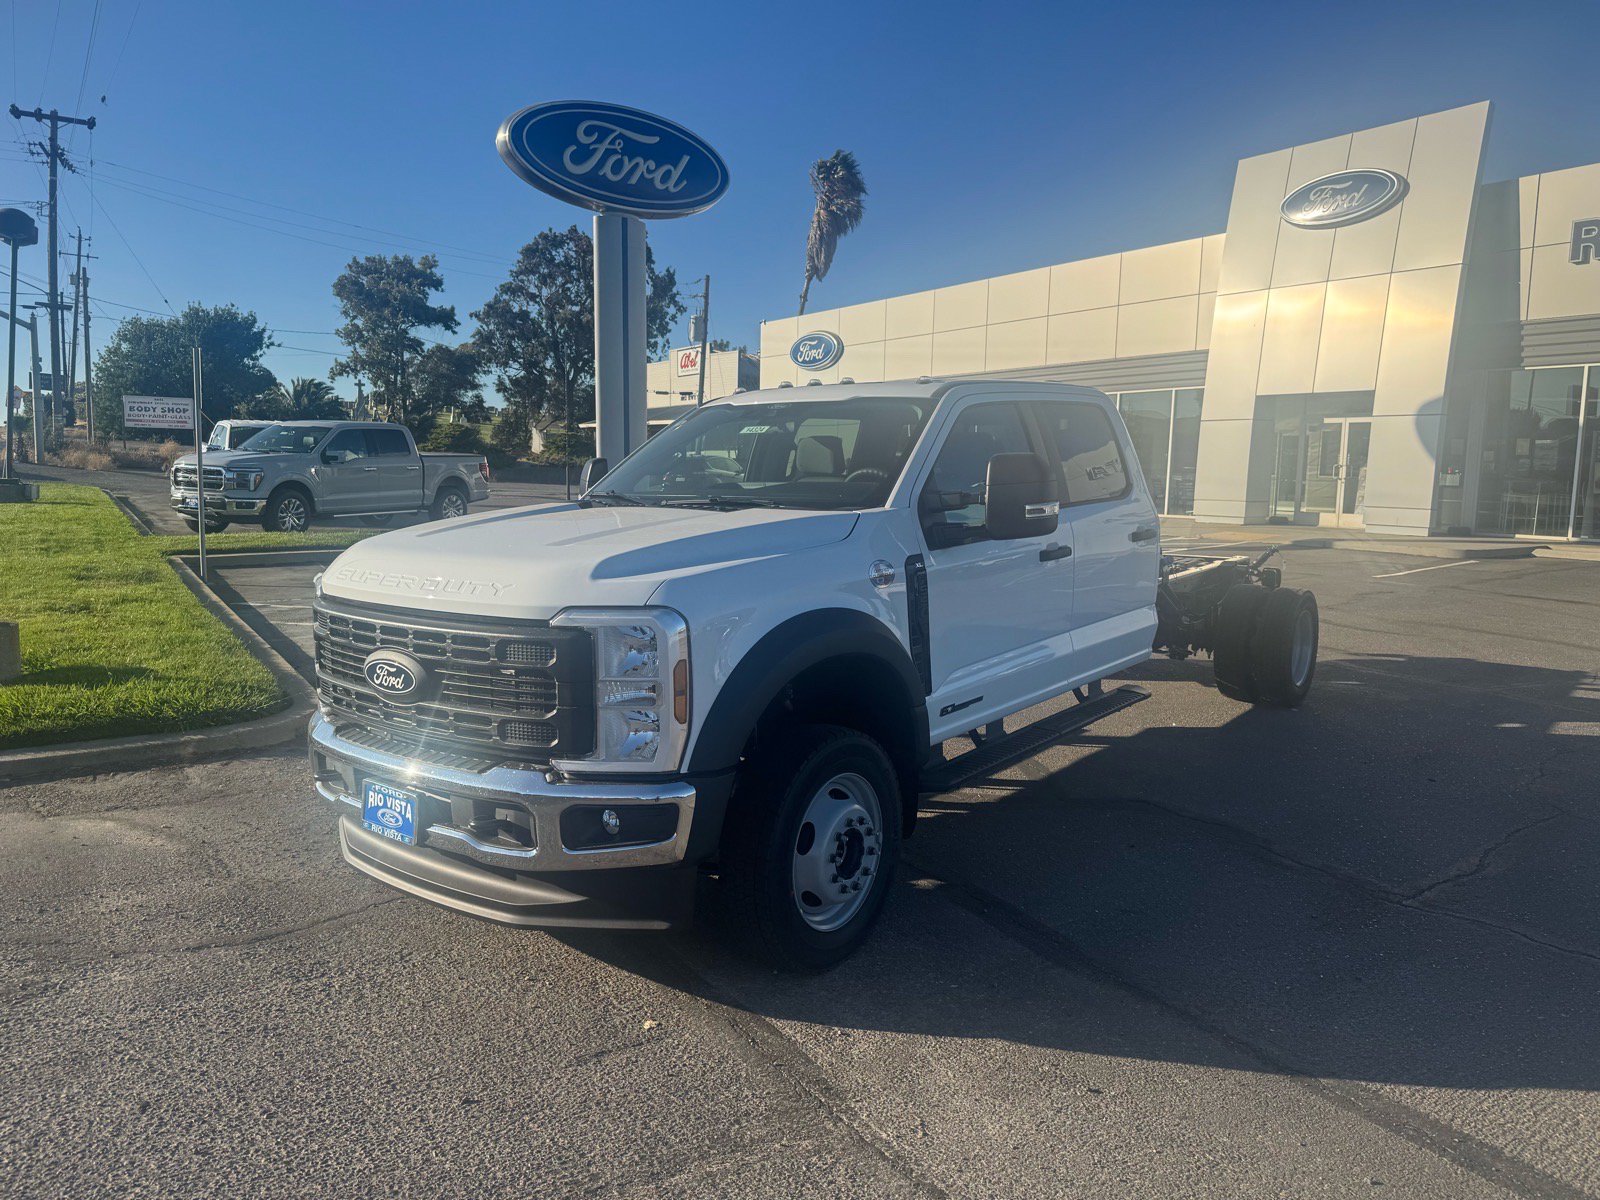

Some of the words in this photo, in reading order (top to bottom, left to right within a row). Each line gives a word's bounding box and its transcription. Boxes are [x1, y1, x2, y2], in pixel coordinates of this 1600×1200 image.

[563, 119, 690, 193] Ford
[1302, 181, 1369, 213] Ford
[797, 340, 825, 362] Ford
[128, 405, 157, 413] BODY
[160, 406, 189, 414] SHOP
[337, 568, 419, 590] SUPER
[419, 576, 516, 599] DUTY
[373, 663, 405, 689] Ford
[375, 785, 403, 799] FORD
[368, 790, 384, 808] RIO
[386, 795, 412, 824] VISTA
[371, 824, 383, 833] RIO
[384, 827, 402, 841] VISTA
